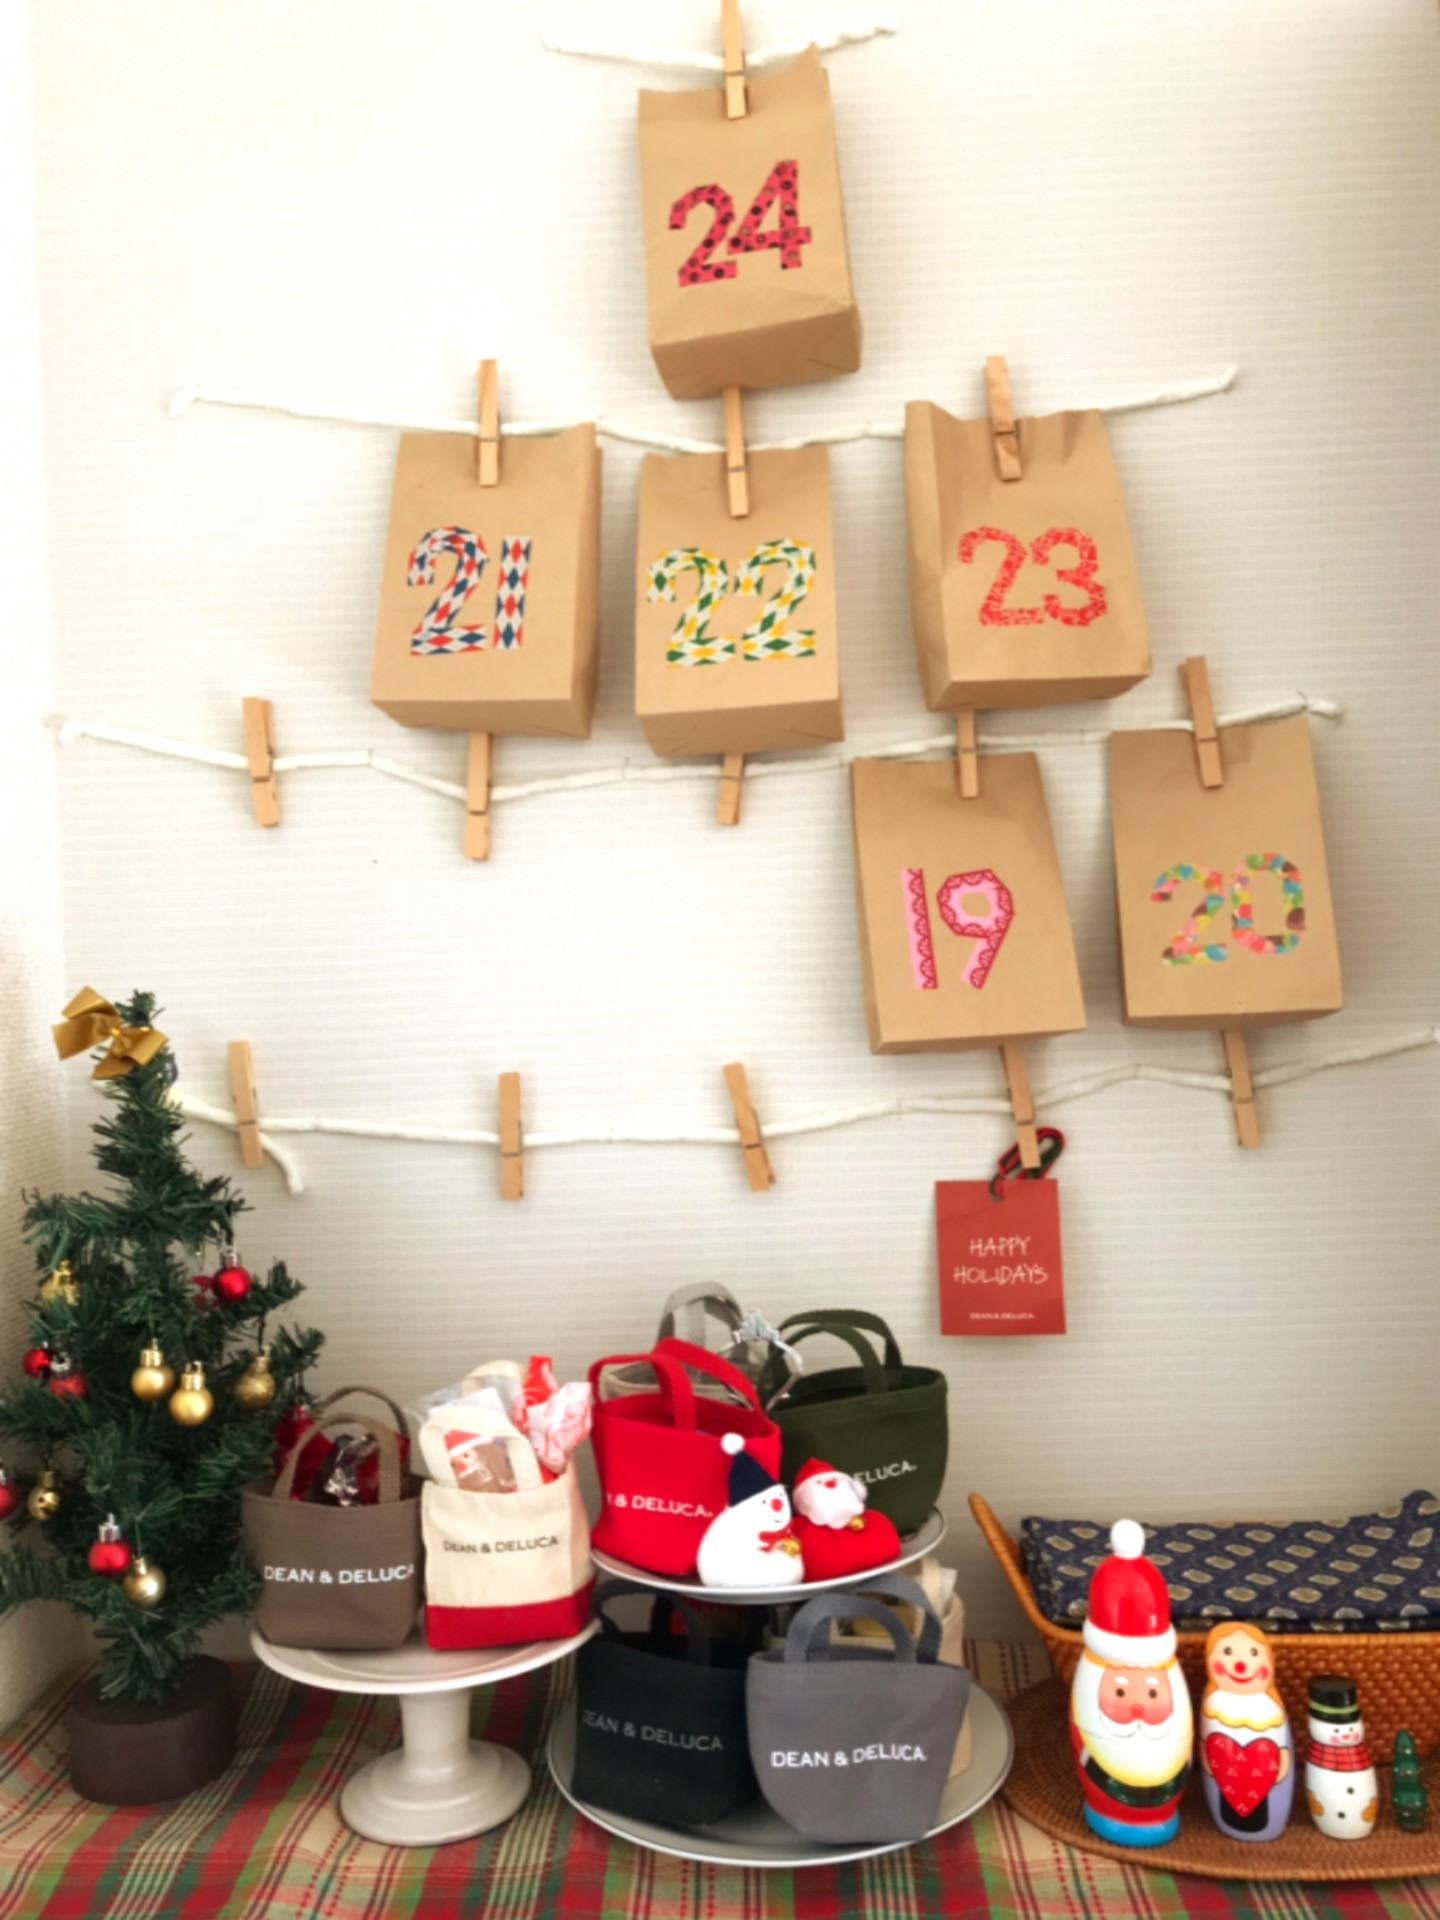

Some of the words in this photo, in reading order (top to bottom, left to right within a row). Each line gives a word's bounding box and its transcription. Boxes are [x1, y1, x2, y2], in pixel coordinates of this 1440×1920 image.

[669, 159, 812, 285] 24
[958, 526, 1108, 627] 23
[407, 526, 532, 656] 21
[646, 538, 817, 668] 22
[1150, 852, 1306, 966] 20
[901, 868, 1015, 990] 19
[969, 1236, 1031, 1257] HAPPY
[952, 1264, 1048, 1286] HOLIDAYS
[852, 1460, 918, 1484] ELUCA
[614, 1493, 627, 1508] &
[443, 1540, 477, 1553] DEAN
[480, 1542, 491, 1553] &
[495, 1535, 559, 1553] DELUCA
[264, 1565, 315, 1583] DEAN
[319, 1570, 333, 1584] &
[623, 1722, 636, 1737] &
[641, 1725, 723, 1751] DELUCA
[771, 1751, 830, 1767] DEAN
[834, 1751, 848, 1766] &
